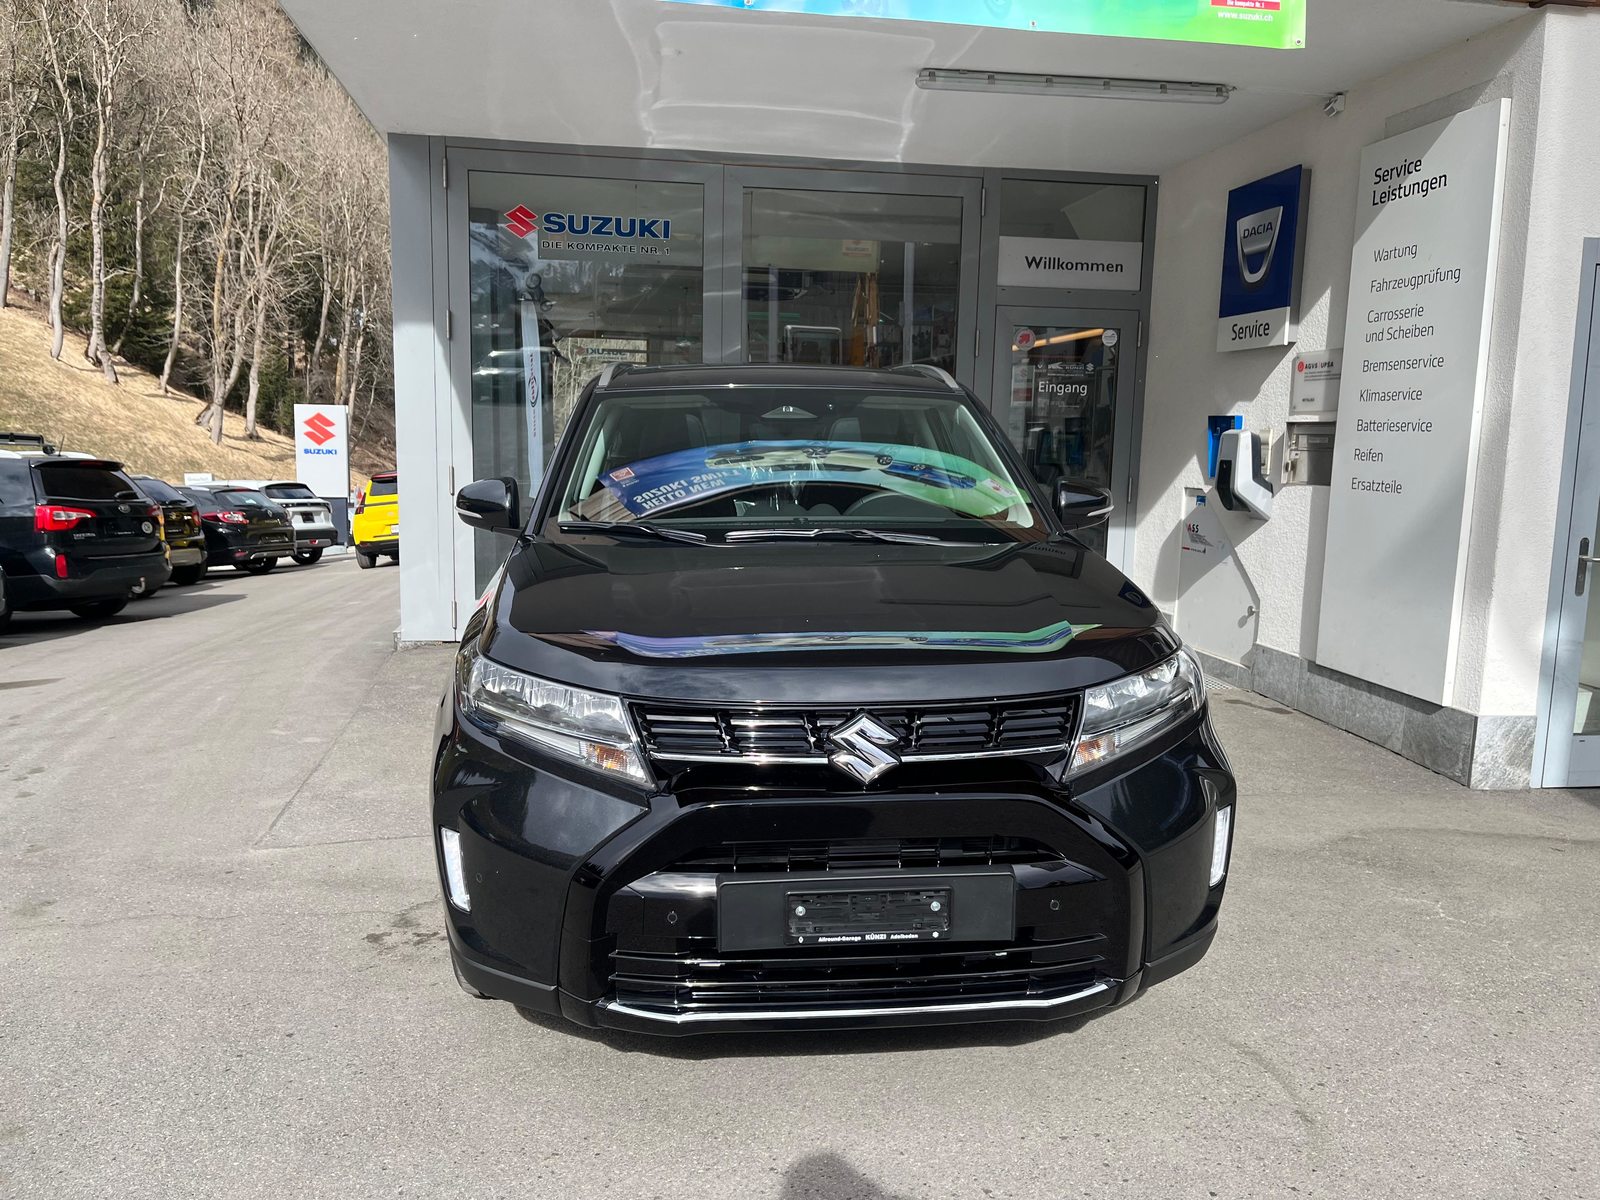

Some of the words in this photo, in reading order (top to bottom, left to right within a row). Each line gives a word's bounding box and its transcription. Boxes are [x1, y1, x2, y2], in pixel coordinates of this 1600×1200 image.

[1217, 11, 1273, 21] www.suzuki.ch
[1373, 158, 1422, 185] Service
[1372, 173, 1447, 206] Leistungen
[542, 212, 671, 240] SUZUKI
[1243, 221, 1273, 239] DACIA
[542, 240, 562, 249] DIE
[567, 242, 636, 253] KOMPAKTE
[640, 246, 660, 254] NR.
[1373, 244, 1418, 262] Wartung
[1025, 255, 1124, 273] Willkommen
[1370, 267, 1461, 293] Fahrzeugprüfung
[1367, 303, 1424, 324] Carrosserie
[1231, 319, 1270, 341] Service
[1365, 327, 1385, 343] und
[1386, 323, 1434, 341] Scheiben
[1362, 354, 1445, 373] Bremsenservice
[1038, 380, 1088, 397] Eingang
[1360, 387, 1423, 402] Klimaservice
[1356, 418, 1433, 433] Batterieservice
[303, 447, 338, 456] SUZUKI
[1353, 448, 1384, 463] Reifen
[1351, 477, 1403, 495] Ersatzteile
[864, 932, 887, 940] KÜNZI
